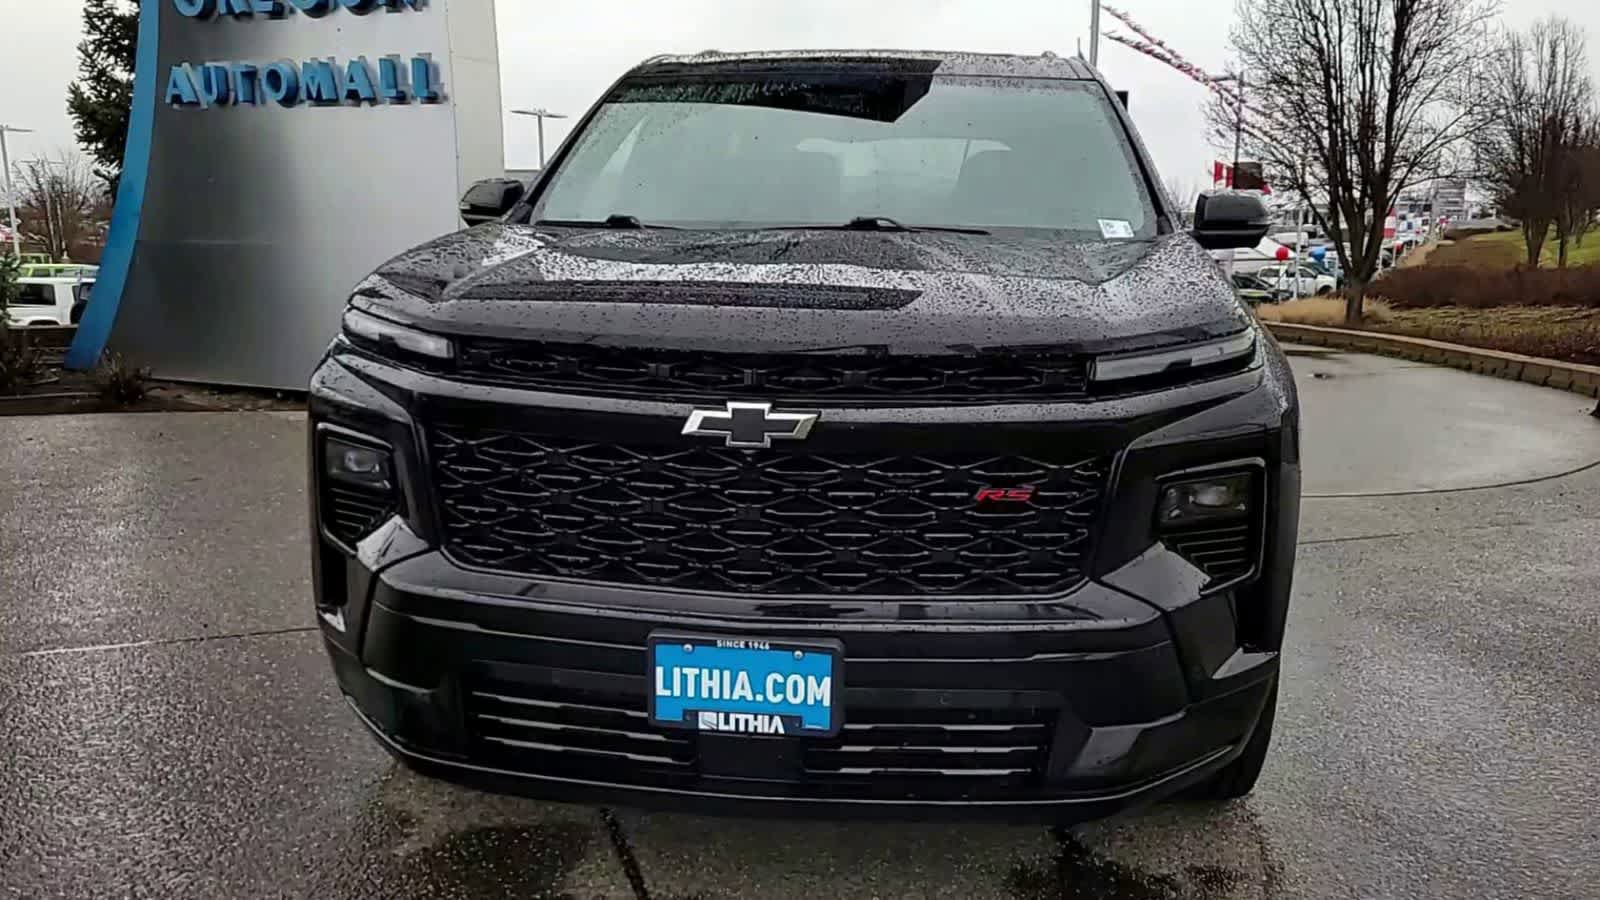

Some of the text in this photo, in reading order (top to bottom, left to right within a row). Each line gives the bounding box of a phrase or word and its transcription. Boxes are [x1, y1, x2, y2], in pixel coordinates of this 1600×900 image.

[165, 54, 444, 107] AUTOMALL
[975, 487, 1034, 502] RS
[716, 639, 746, 649] SINCE
[655, 666, 832, 707] LITHIA.COM
[718, 712, 785, 735] LITHIA
